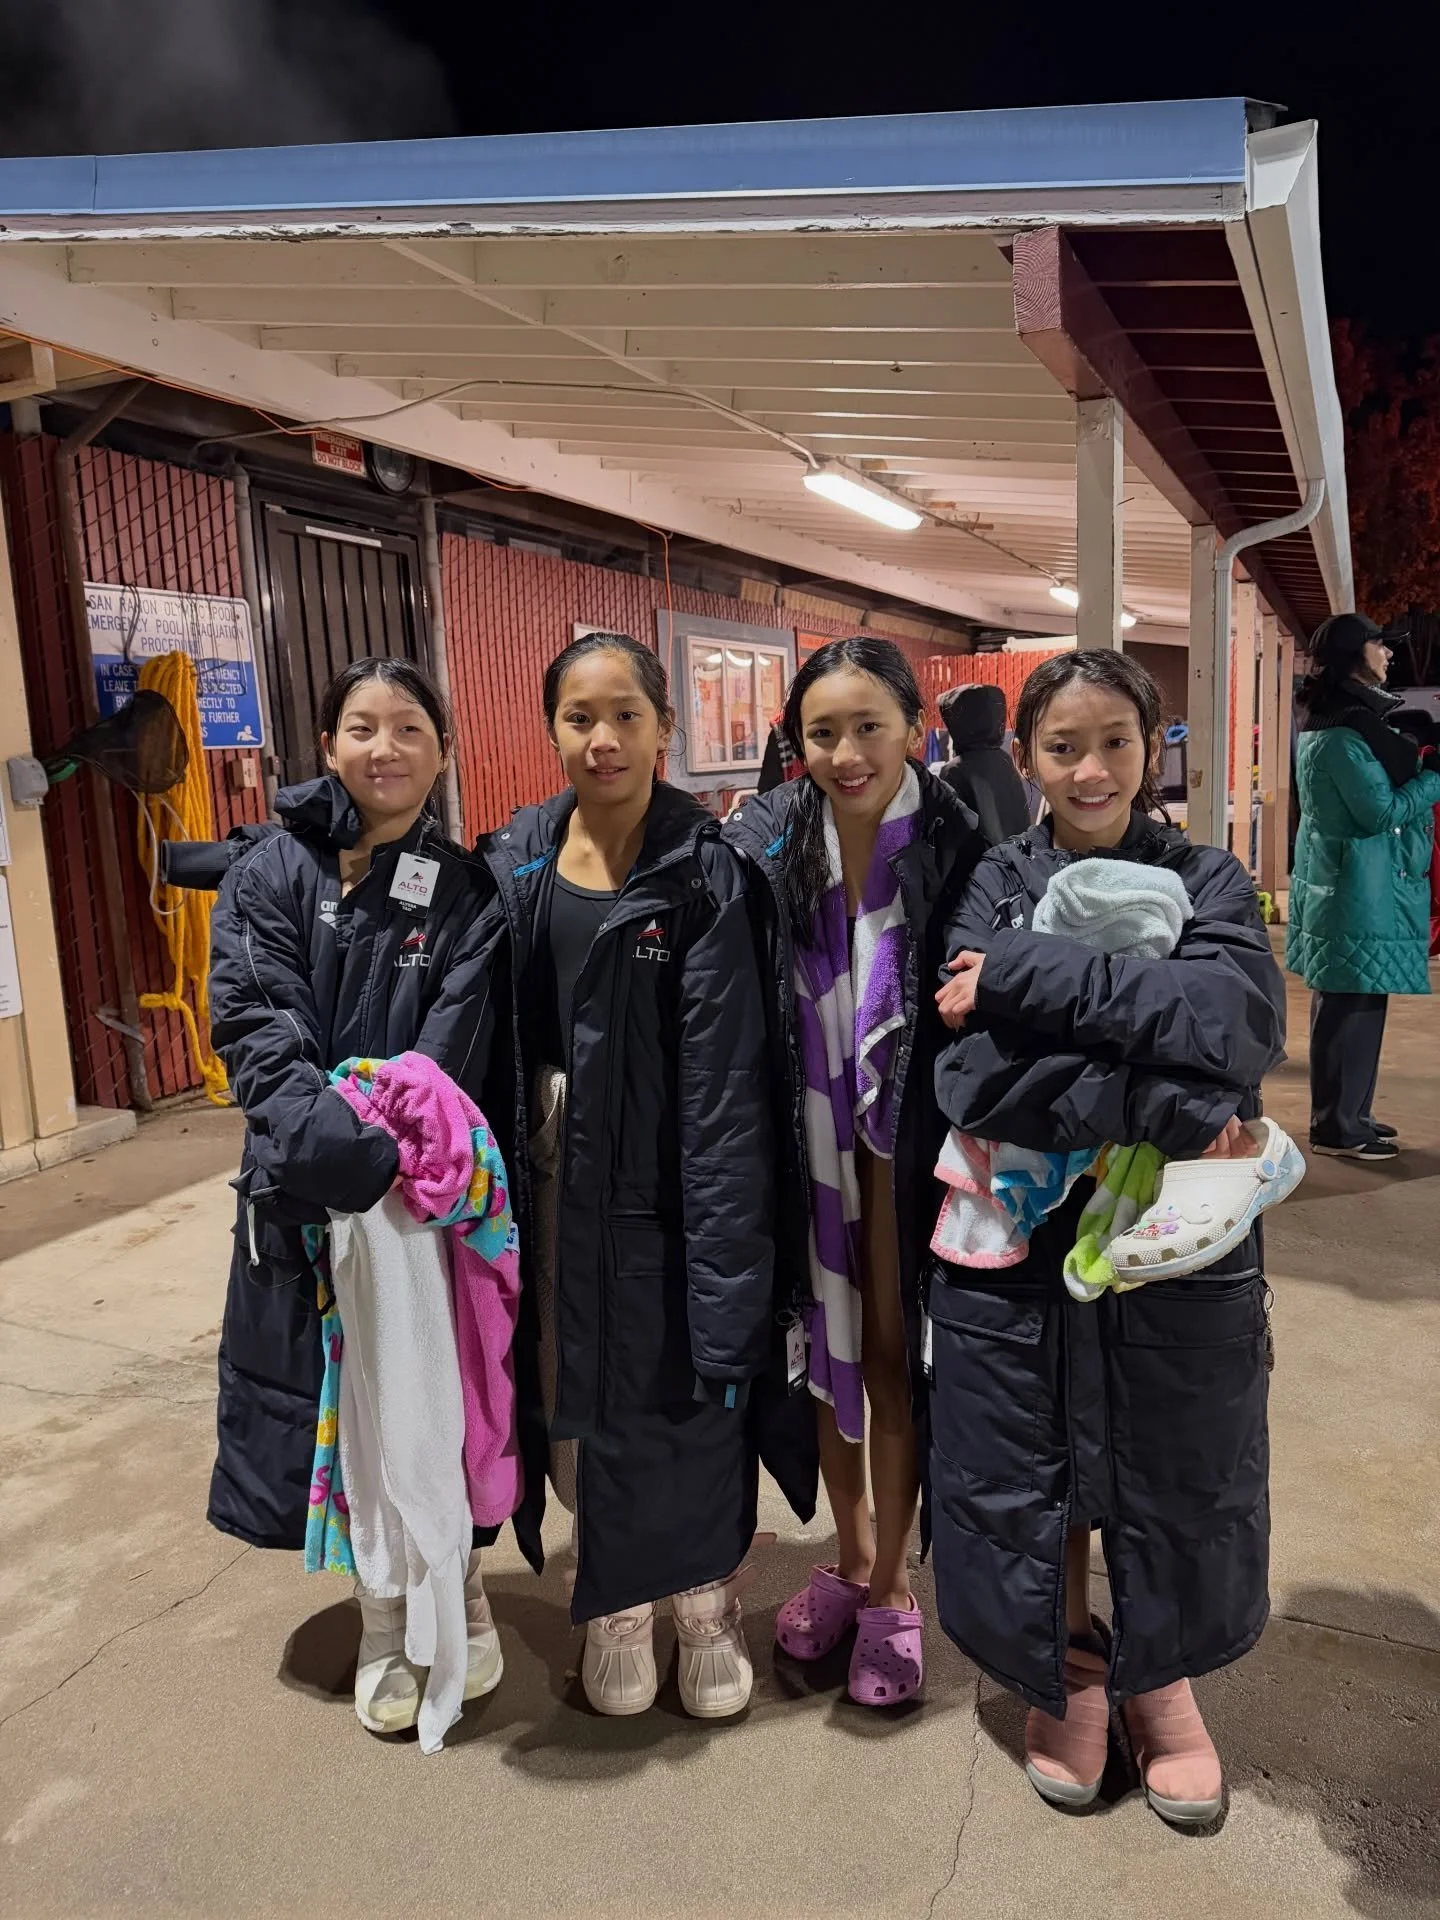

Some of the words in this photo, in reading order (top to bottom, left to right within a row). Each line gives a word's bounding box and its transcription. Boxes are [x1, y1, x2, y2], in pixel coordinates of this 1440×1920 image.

[330, 444, 347, 459] EXIT
[89, 594, 112, 611] SAN
[155, 619, 184, 635] POOL
[100, 663, 110, 676] IN
[112, 664, 135, 677] CASE
[103, 680, 130, 692] LEAVE
[226, 697, 236, 709] TO
[208, 711, 240, 724] FURTHER
[398, 881, 428, 894] ALTO
[633, 945, 670, 962] LTO
